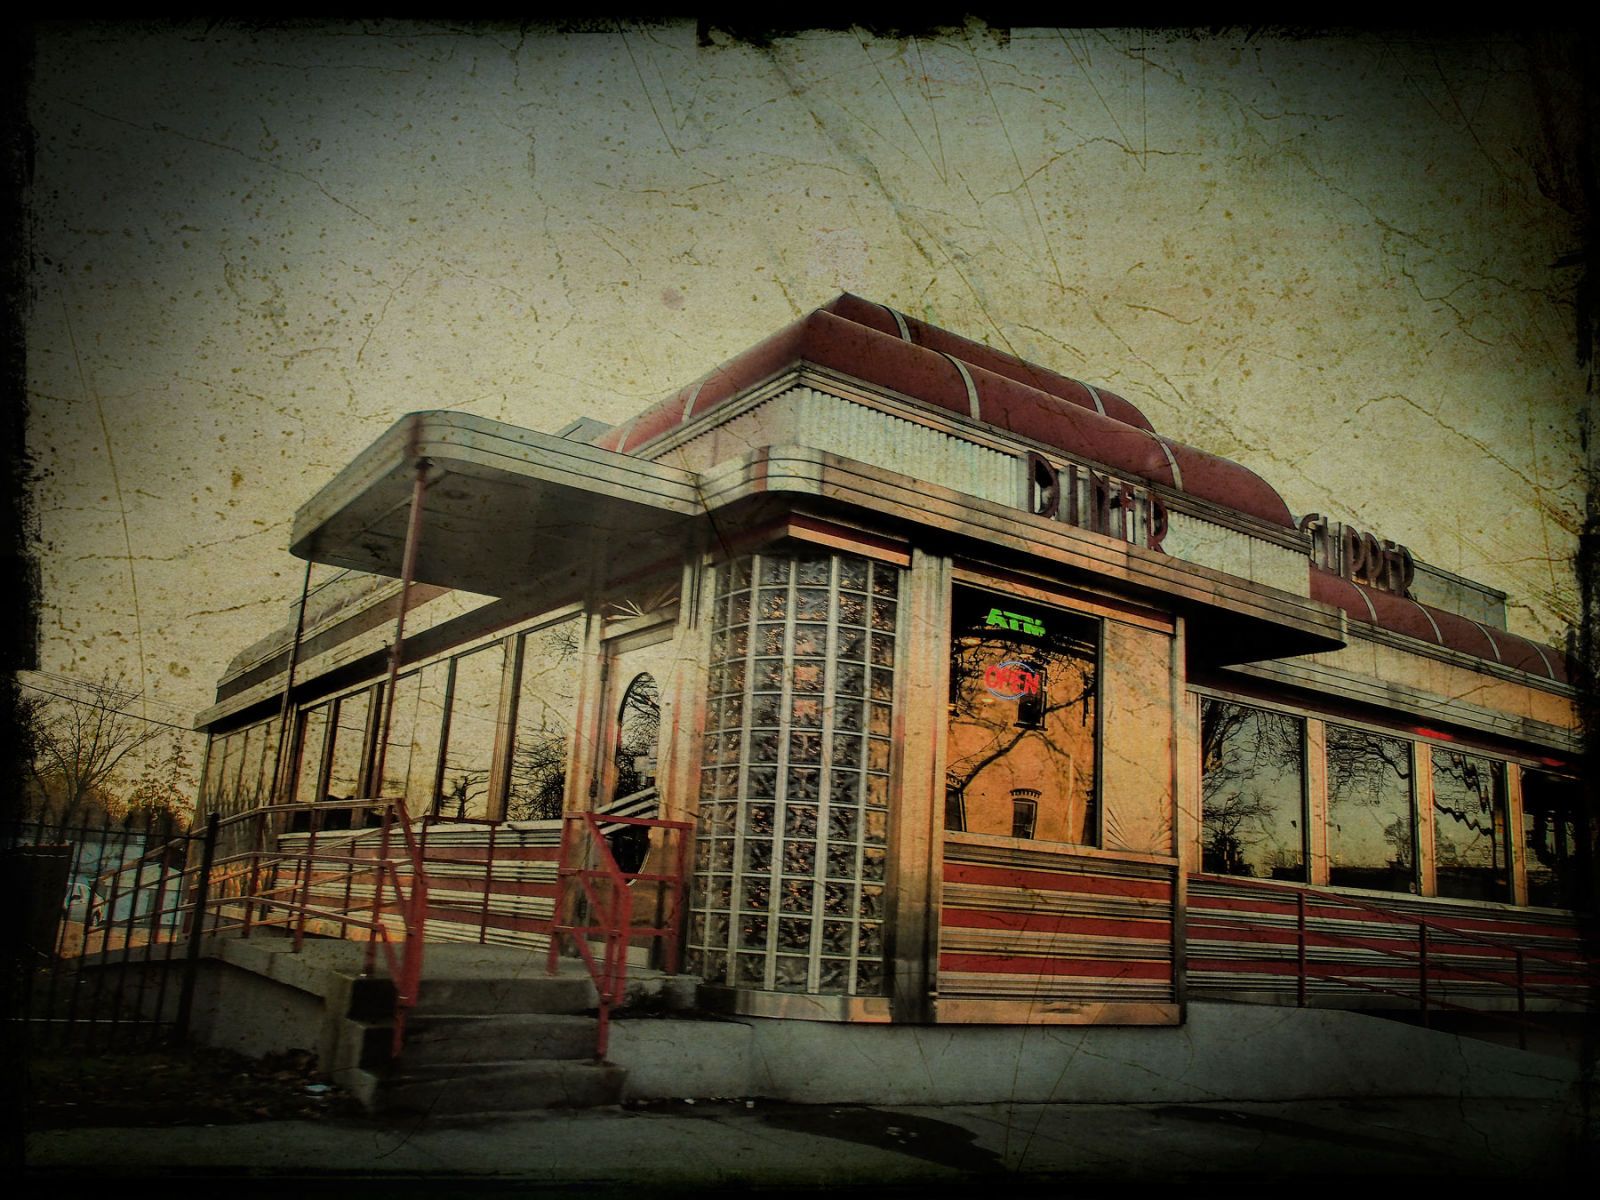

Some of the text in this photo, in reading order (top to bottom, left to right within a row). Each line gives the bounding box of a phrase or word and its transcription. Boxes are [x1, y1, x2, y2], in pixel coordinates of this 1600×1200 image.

[1028, 450, 1167, 553] DINER
[985, 607, 1047, 637] ATM
[984, 664, 1040, 695] OPEN
